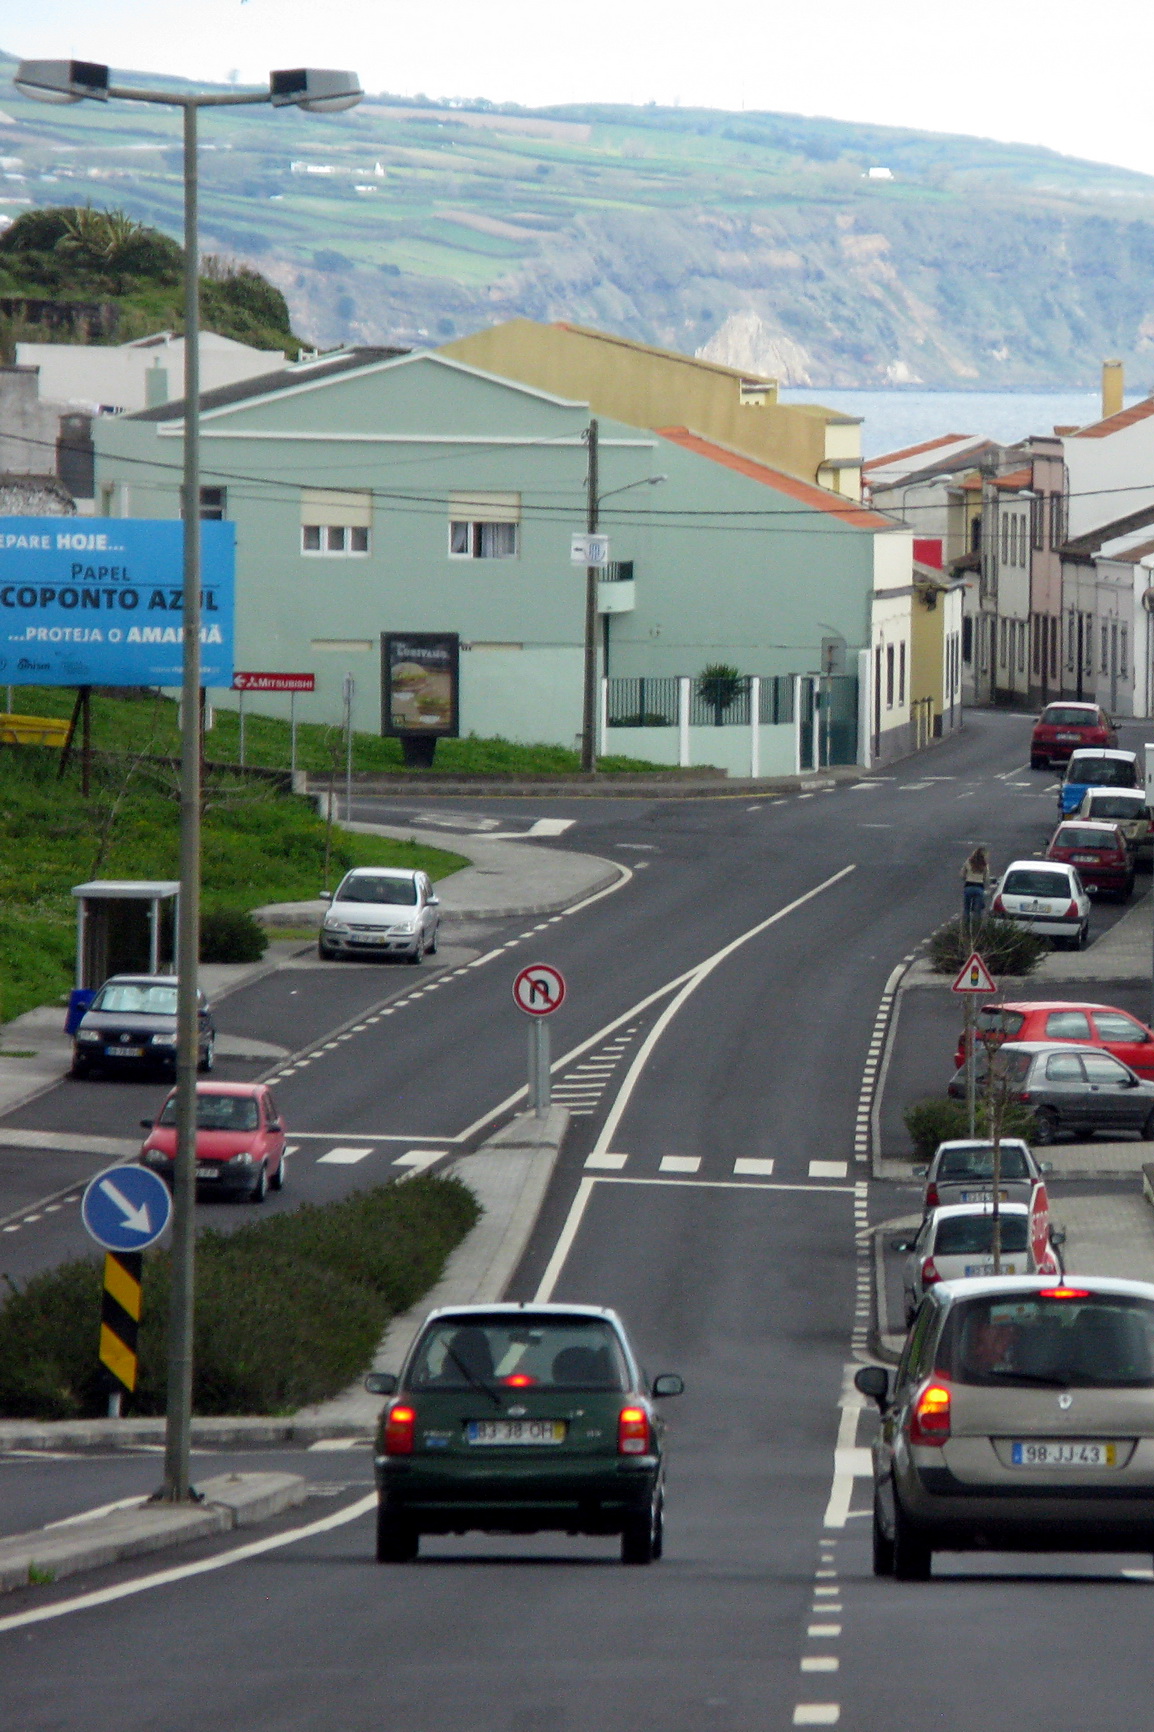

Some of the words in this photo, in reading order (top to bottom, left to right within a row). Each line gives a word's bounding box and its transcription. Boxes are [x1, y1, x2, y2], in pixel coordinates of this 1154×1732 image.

[0, 586, 139, 610] COPONTO
[148, 590, 219, 611] AZL
[108, 628, 122, 642] O
